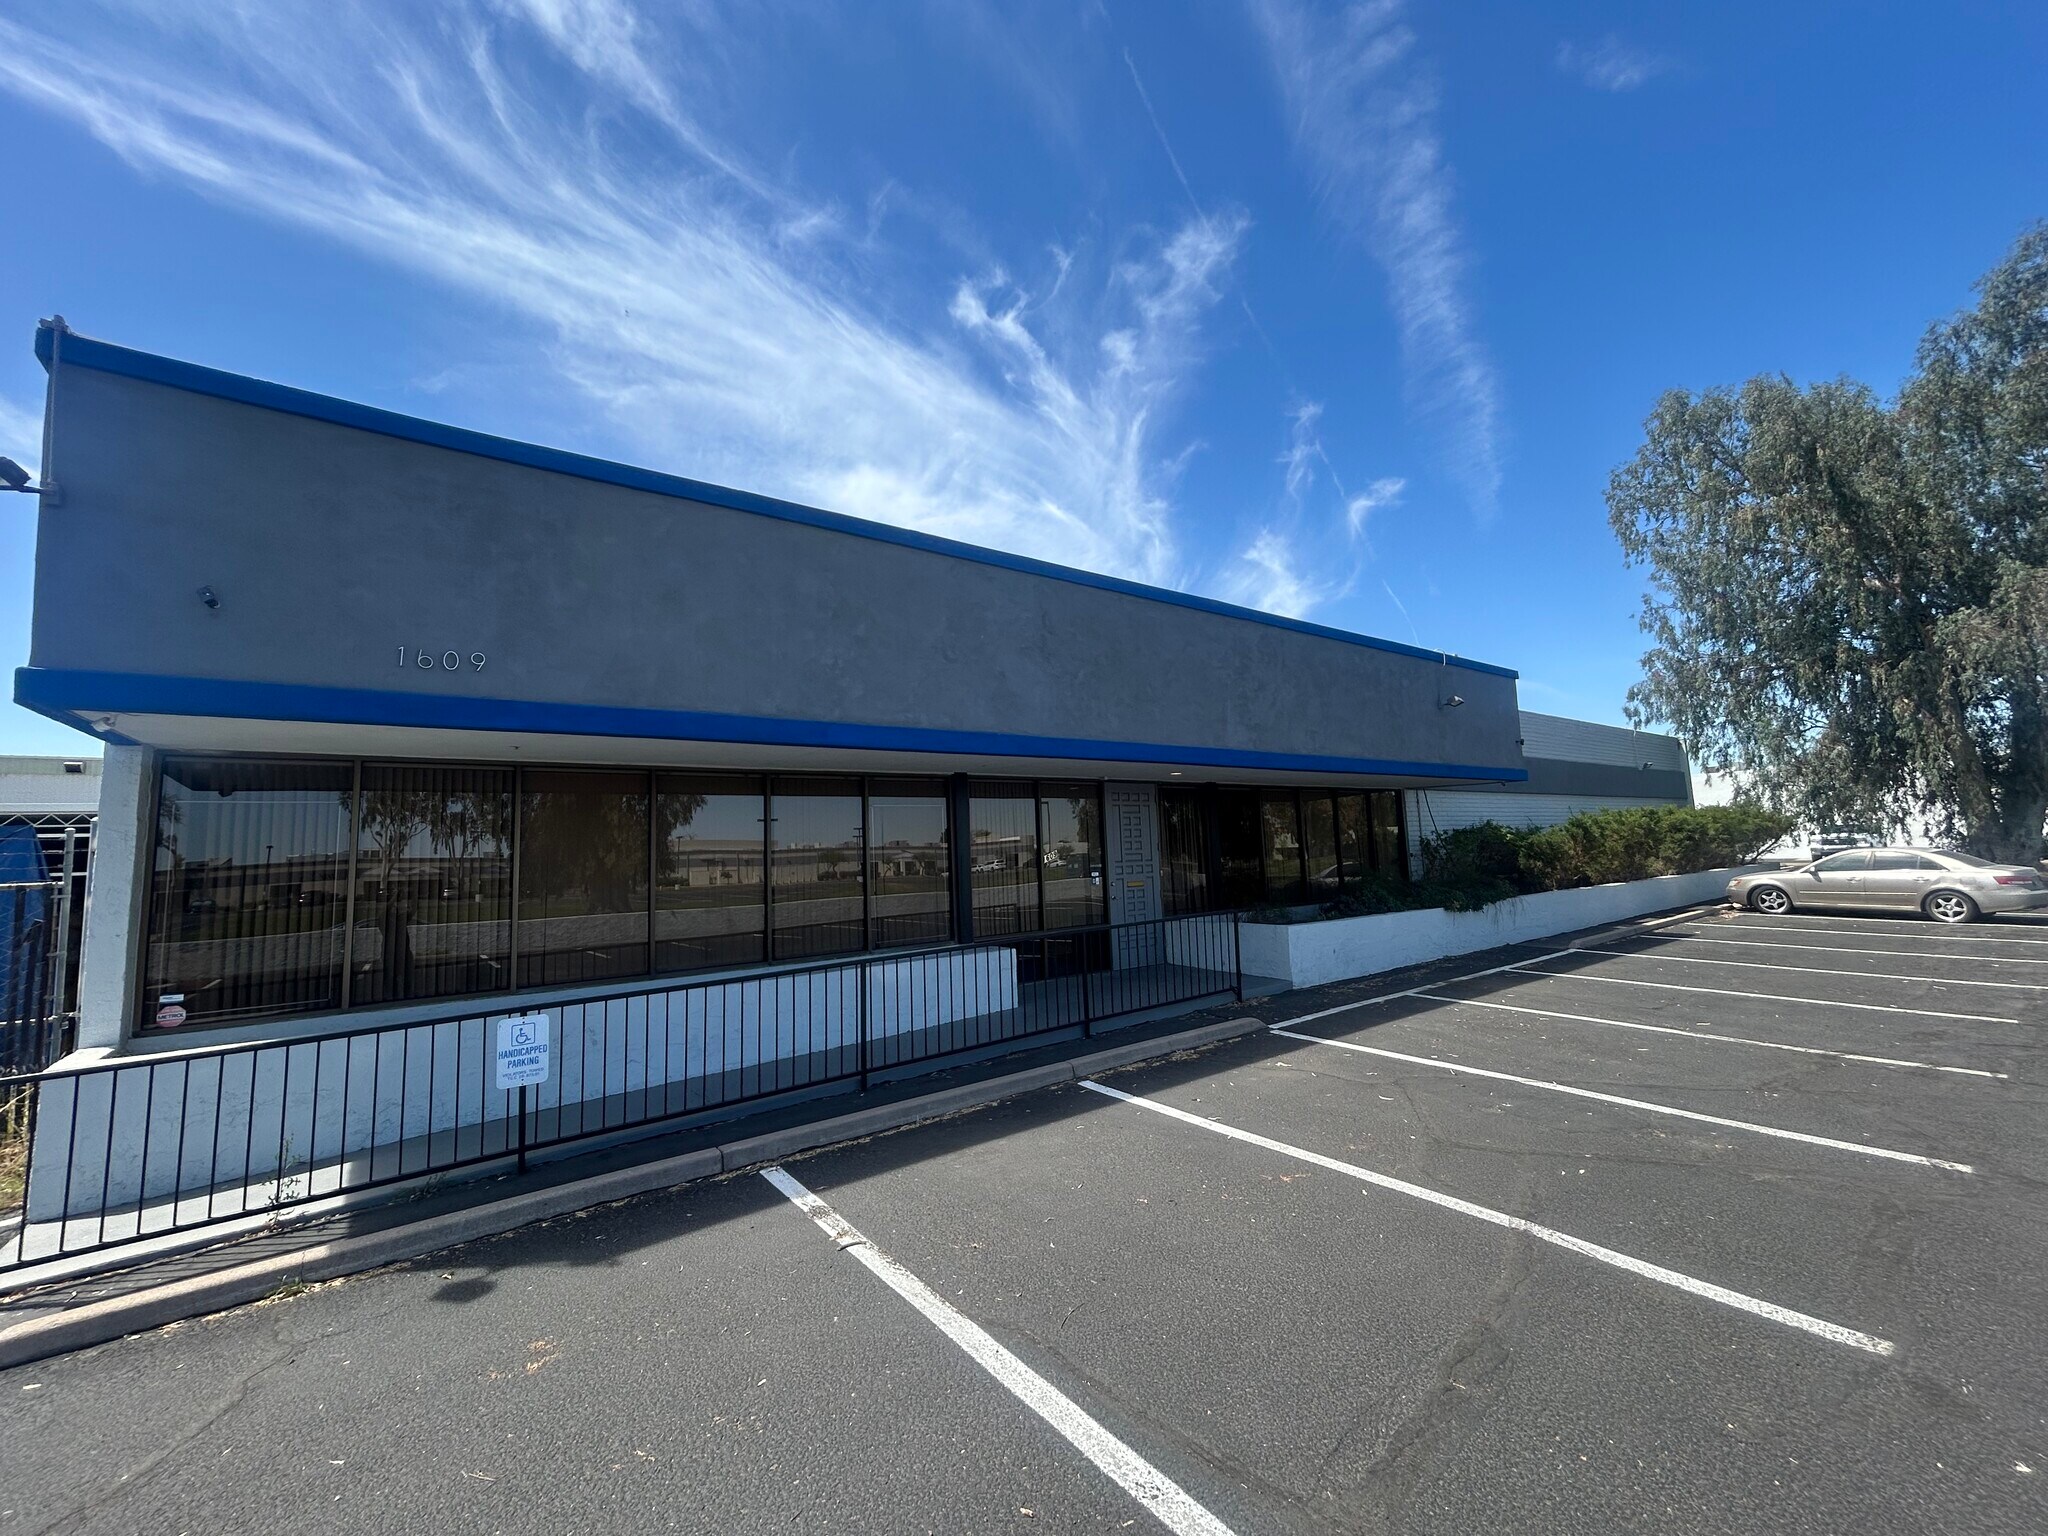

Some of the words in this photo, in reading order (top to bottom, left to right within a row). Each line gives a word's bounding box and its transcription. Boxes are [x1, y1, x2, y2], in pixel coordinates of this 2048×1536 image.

[398, 646, 486, 672] 1609
[498, 1044, 548, 1060] HANDICAPPED
[507, 1055, 540, 1069] PARKING
